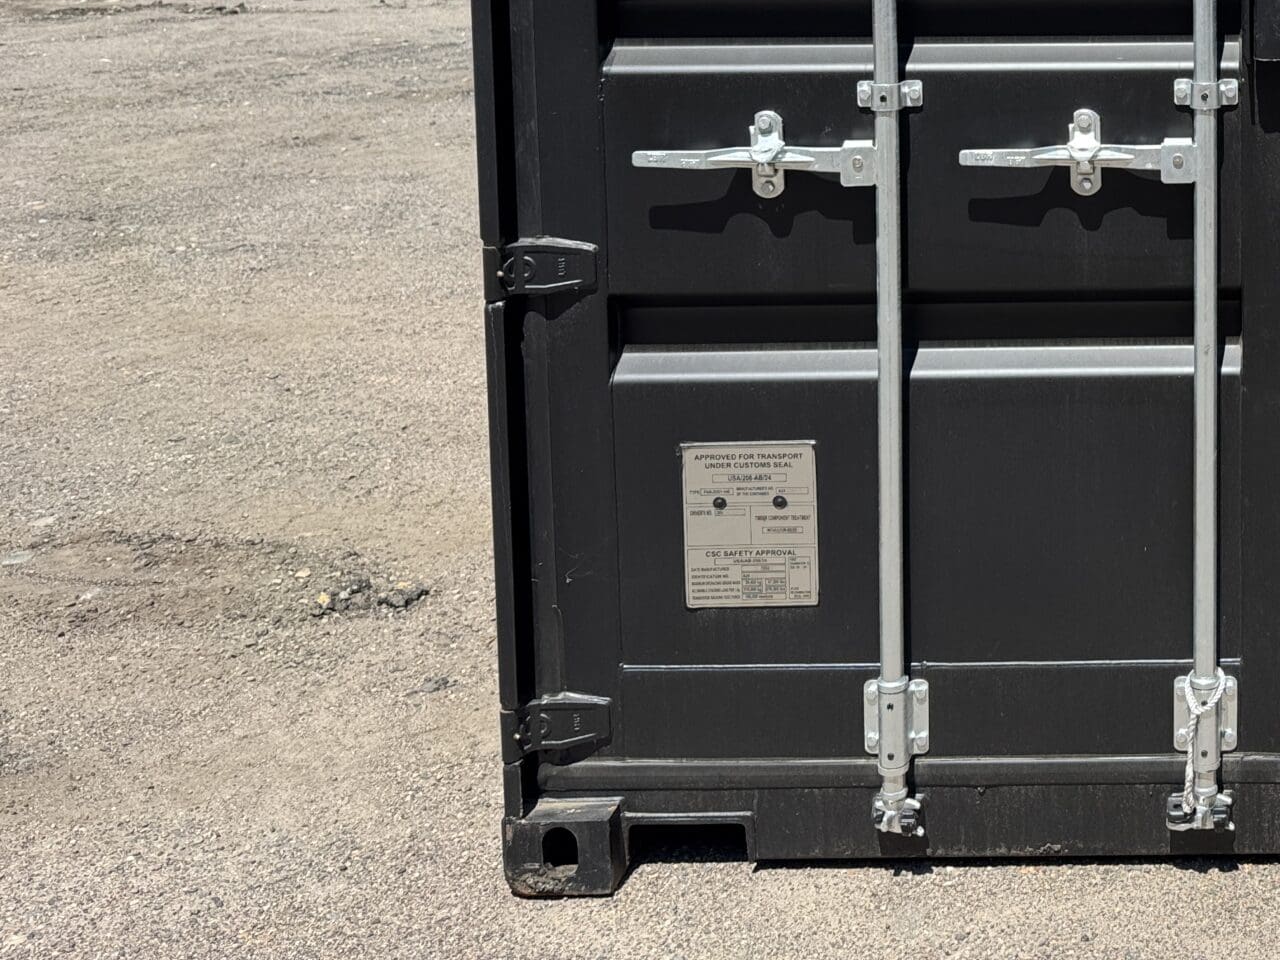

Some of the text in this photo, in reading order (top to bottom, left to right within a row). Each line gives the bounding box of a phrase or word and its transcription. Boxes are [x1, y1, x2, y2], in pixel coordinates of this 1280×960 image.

[694, 453, 737, 461] APPROVED
[756, 452, 803, 460] TRANSPORT
[733, 461, 772, 469] CUSTOMS
